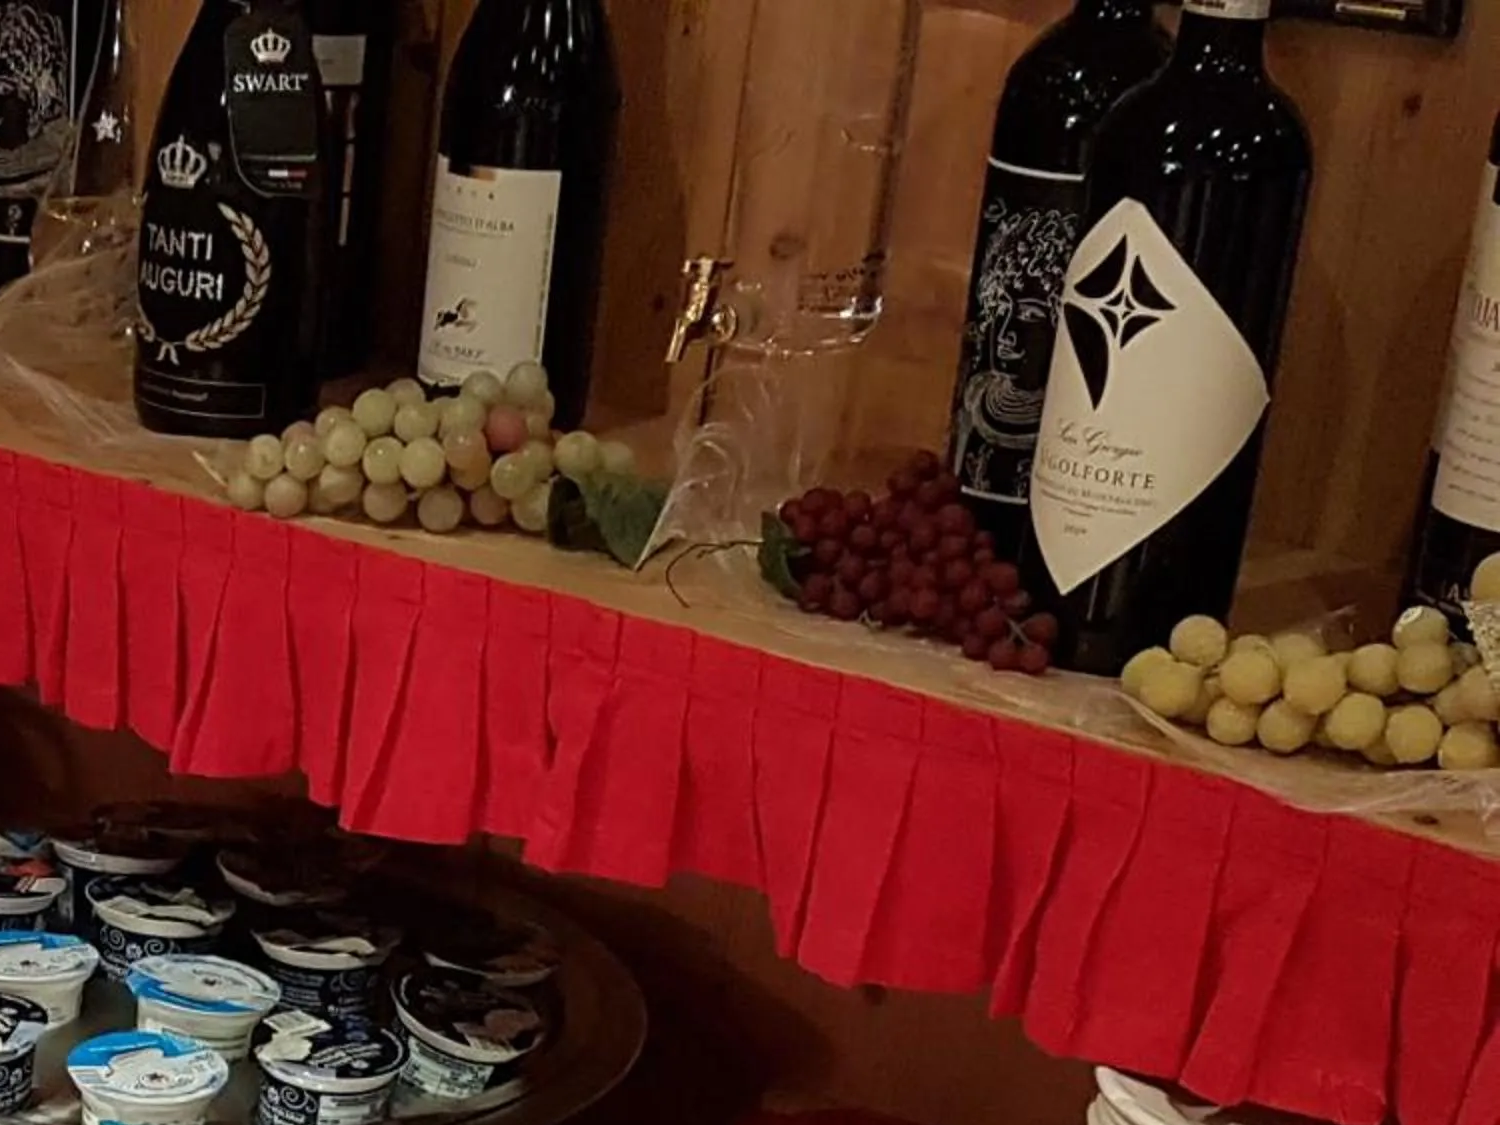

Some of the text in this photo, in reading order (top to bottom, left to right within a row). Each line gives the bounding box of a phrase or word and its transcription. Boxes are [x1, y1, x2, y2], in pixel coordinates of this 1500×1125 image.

[233, 73, 304, 93] SWART
[147, 222, 214, 262] TANTI
[139, 259, 225, 303] AUGURI
